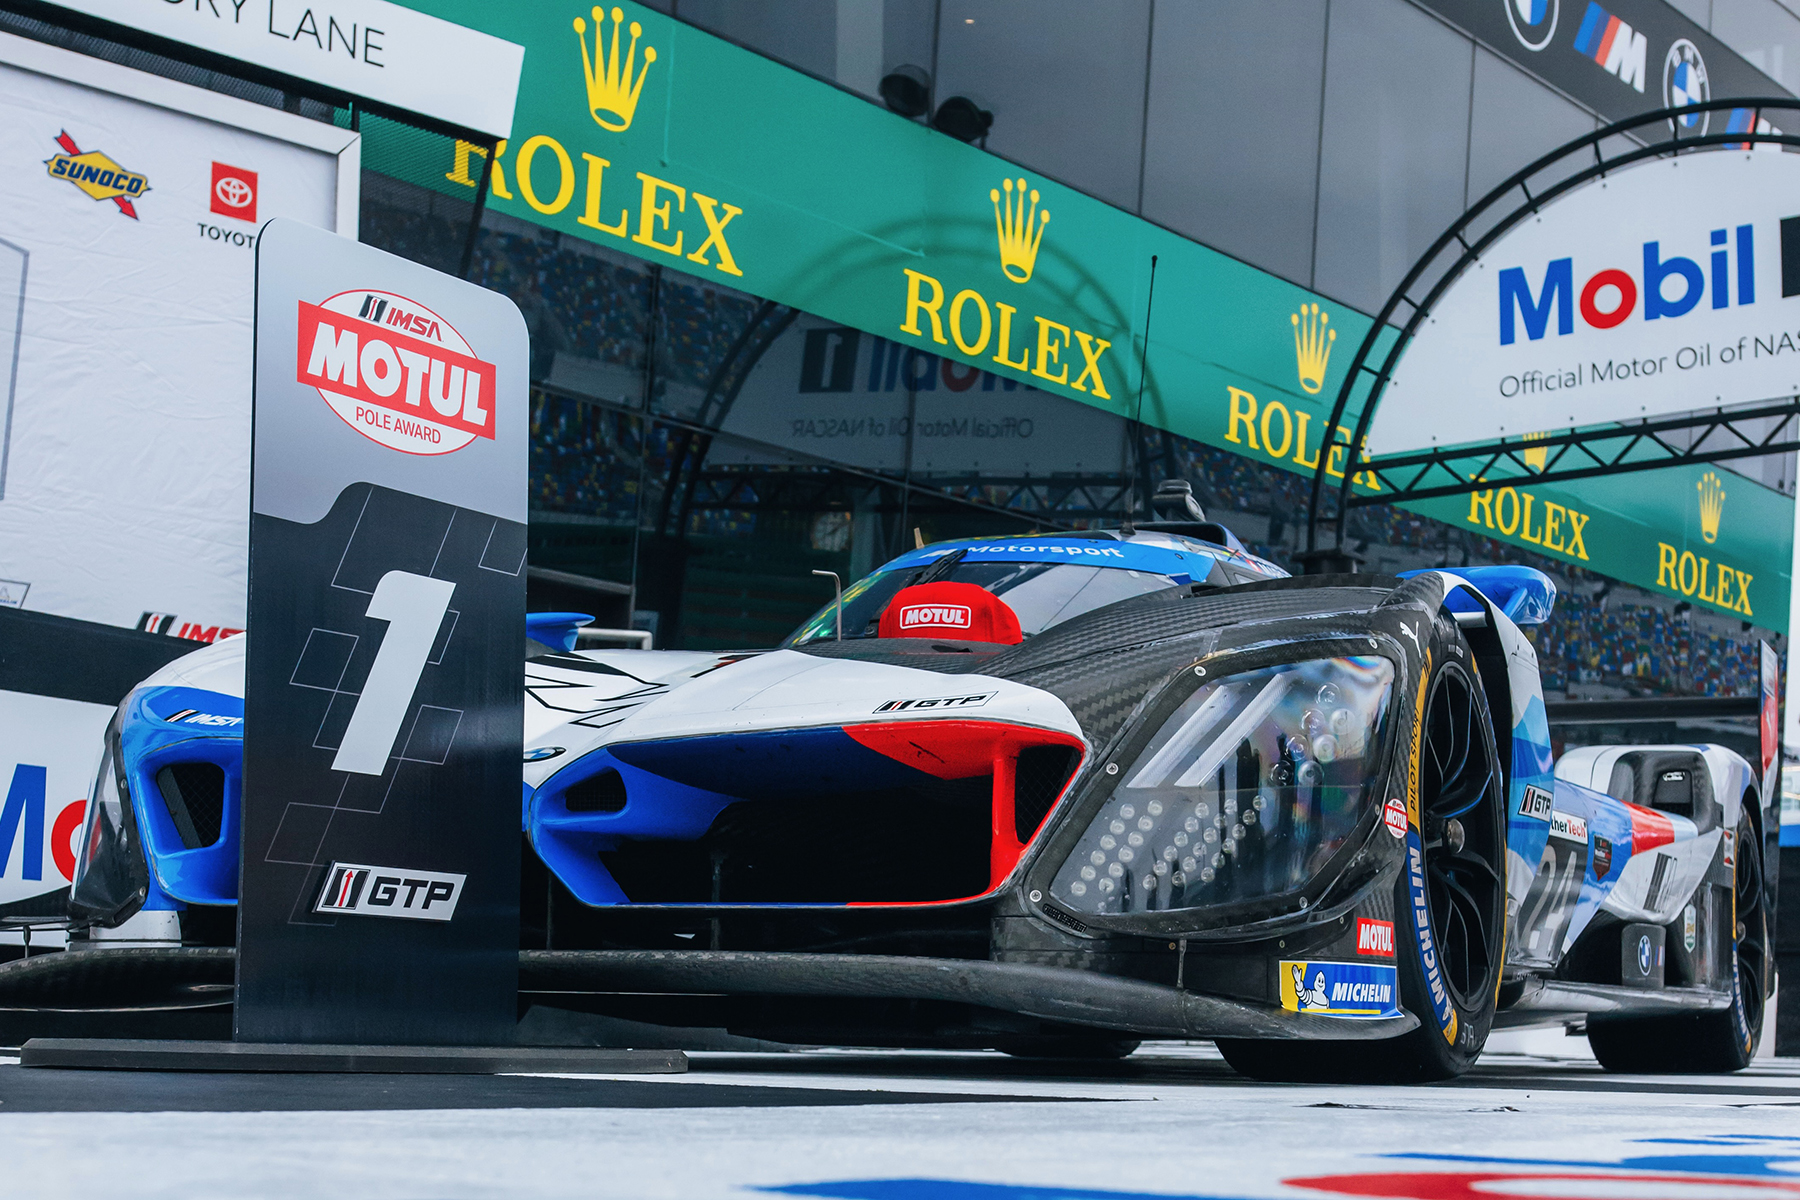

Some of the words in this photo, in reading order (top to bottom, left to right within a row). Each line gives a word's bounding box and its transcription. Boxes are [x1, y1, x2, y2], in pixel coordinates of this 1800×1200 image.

[268, 0, 386, 68] LANE
[52, 157, 144, 194] SUNOCO
[197, 222, 256, 249] TOYOT
[1498, 223, 1756, 346] Mobil
[385, 306, 442, 342] IMSA
[899, 268, 1112, 400] ROLEX
[306, 321, 488, 427] MOTUL
[1499, 362, 1583, 398] Official
[1591, 358, 1668, 384] Motor
[1675, 343, 1711, 370] Oil
[1719, 336, 1748, 363] of
[1754, 329, 1800, 358] NA
[355, 405, 391, 431] POLE
[393, 417, 442, 444] AWARD
[967, 544, 1125, 558] Motorsport
[1656, 541, 1754, 617] ROLEX
[904, 608, 965, 625] MOTUL
[330, 569, 457, 777] 1
[913, 694, 988, 708] GTP
[1409, 759, 1417, 813] PILOT
[1533, 793, 1552, 815] GTP
[1385, 807, 1407, 830] MOTUL
[1551, 815, 1587, 839] therTech
[367, 875, 455, 910] GTP
[1358, 923, 1393, 952] MOTUL
[1409, 846, 1445, 1006] MICHELIN
[1331, 982, 1392, 1004] MICHELIN
